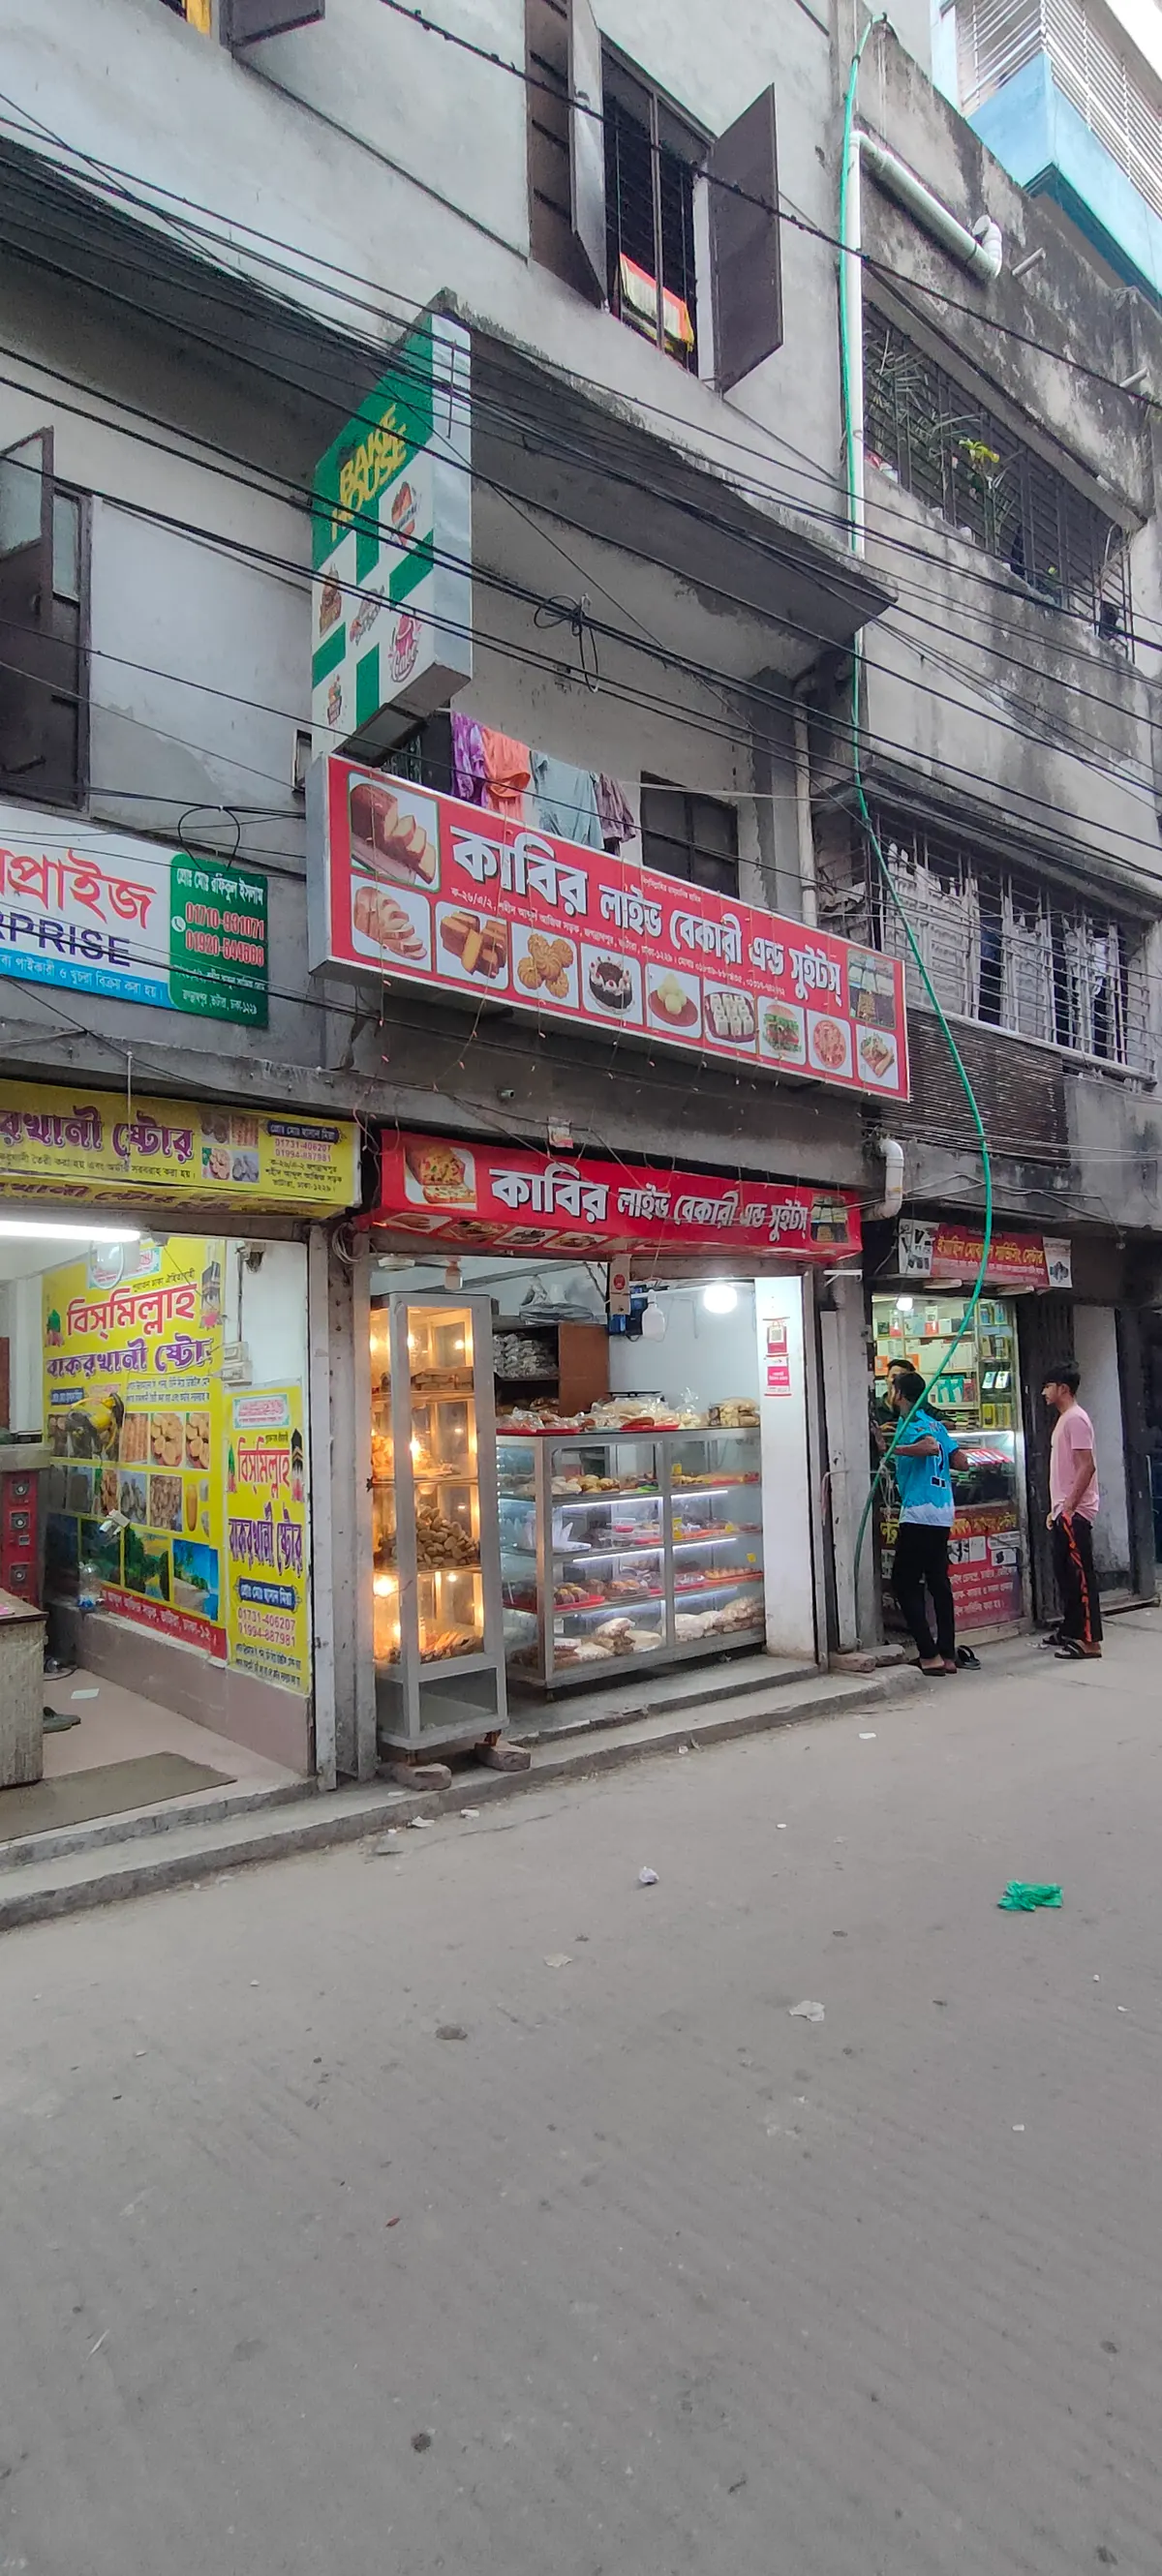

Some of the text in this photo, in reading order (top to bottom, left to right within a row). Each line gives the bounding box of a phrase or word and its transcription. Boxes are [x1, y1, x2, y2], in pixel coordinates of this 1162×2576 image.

[340, 404, 397, 504] BAKE
[239, 877, 263, 905] ইসলাম
[449, 826, 588, 917] কাবির
[598, 884, 662, 937] লাইভ
[670, 910, 743, 965] বেকারী
[751, 937, 784, 975] এন্ড
[15, 957, 55, 977] পাইকারী
[112, 1110, 195, 1165] ষ্টোর
[489, 1162, 610, 1223] কাবির
[617, 1183, 671, 1221] লাইভ
[674, 1191, 740, 1228] বেকারী
[46, 1337, 148, 1379] বাকরখানী
